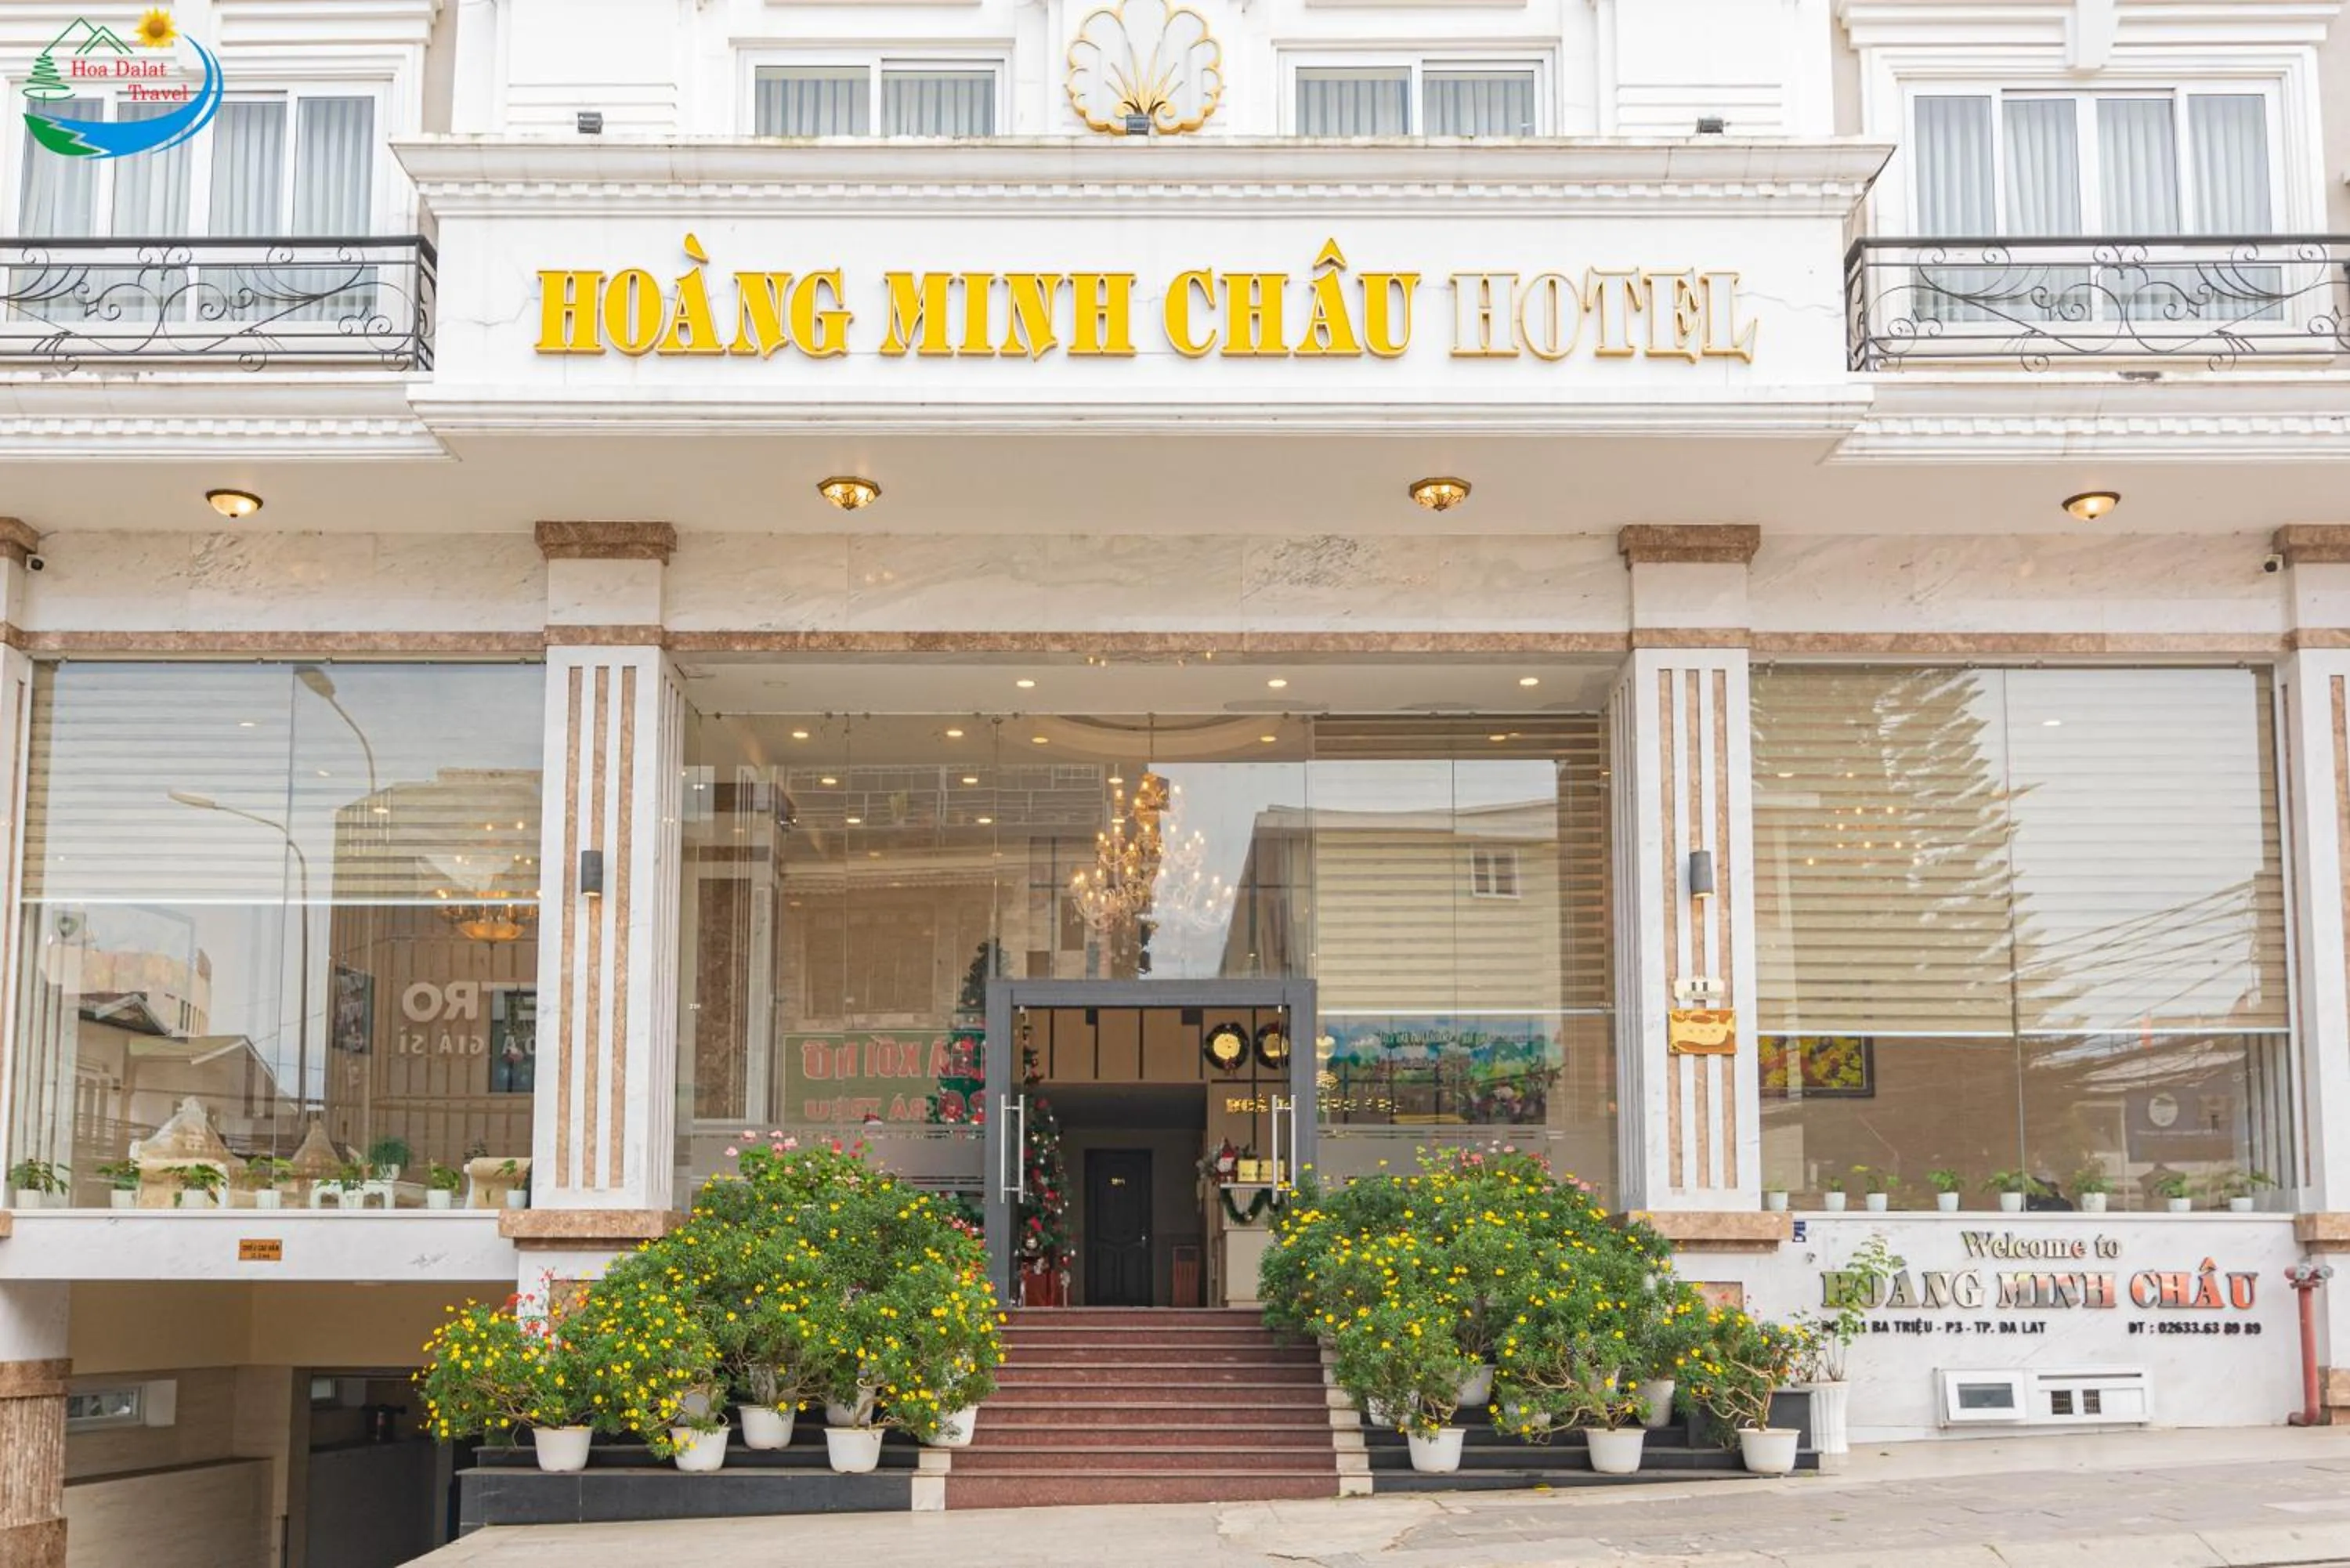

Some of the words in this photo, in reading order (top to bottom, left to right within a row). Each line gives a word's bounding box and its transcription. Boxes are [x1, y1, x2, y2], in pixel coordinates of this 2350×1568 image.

[534, 233, 854, 359] HOÀNG
[879, 270, 1138, 362] MINH
[1163, 237, 1422, 359] CHÂU
[1449, 266, 1759, 364] HOTEL
[1960, 1230, 2088, 1259] Welcome
[2094, 1233, 2123, 1259] to
[1995, 1270, 2119, 1310] MINH
[2130, 1256, 2259, 1310] CHÂU
[1893, 1317, 1933, 1336] TRIỆU
[1945, 1321, 1963, 1334] P3
[1974, 1321, 1995, 1334] TP.
